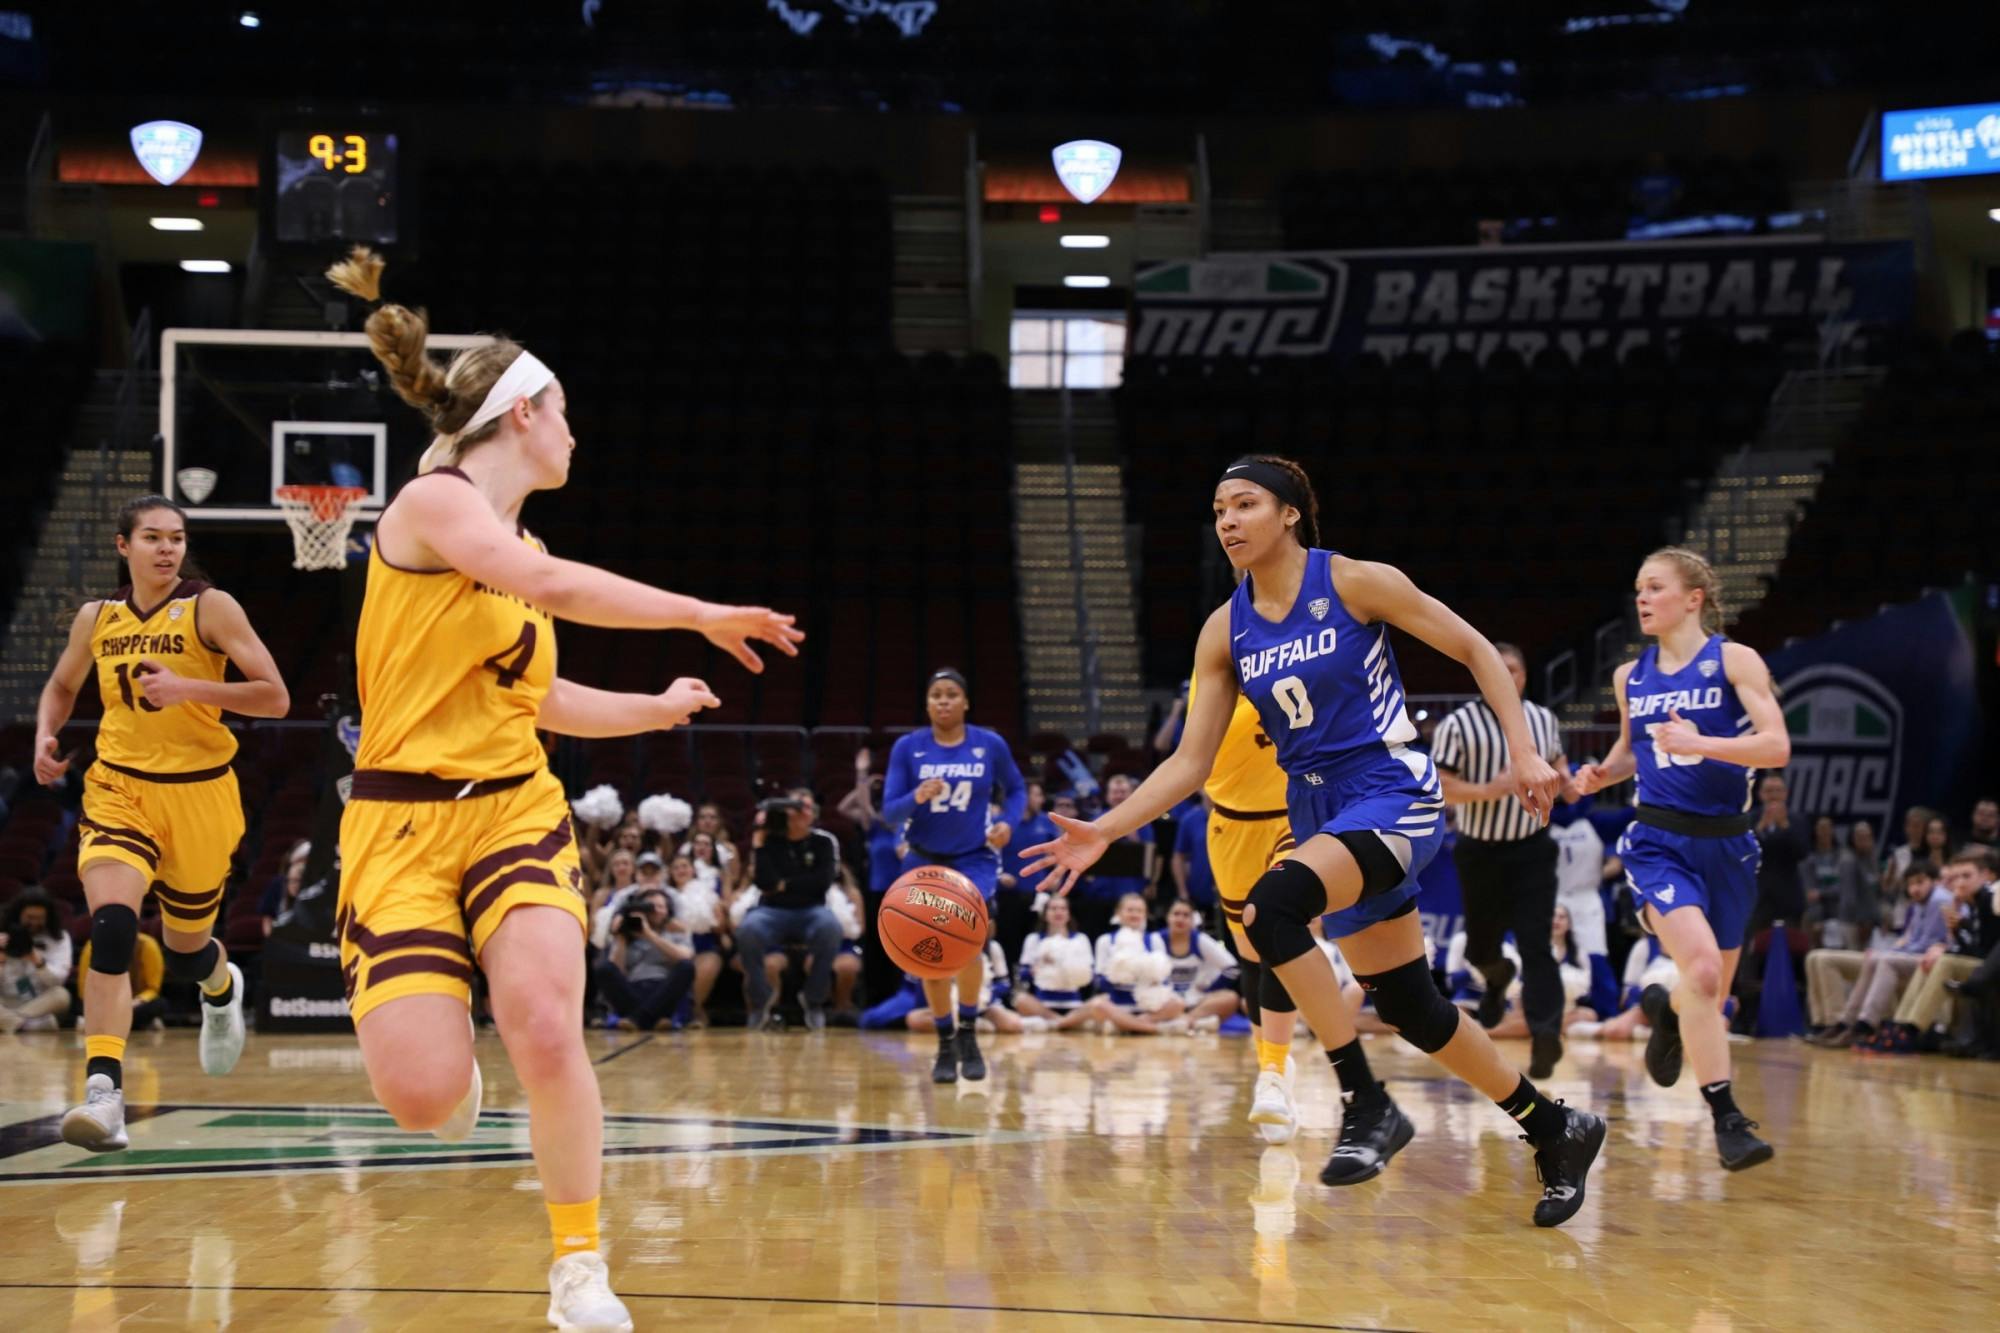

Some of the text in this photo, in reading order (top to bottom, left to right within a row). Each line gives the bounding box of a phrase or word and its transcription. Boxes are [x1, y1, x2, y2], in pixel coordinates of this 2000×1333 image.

[309, 134, 367, 174] 9.3
[1898, 150, 1968, 171] BEACH
[1364, 257, 1856, 326] BASKETBALL
[1134, 307, 1332, 358] MAC
[482, 620, 537, 690] 4
[1239, 627, 1337, 684] BUFFALO
[1271, 675, 1314, 729] 0
[1628, 687, 1722, 719] BUFFALO
[1645, 721, 1704, 769] 1
[918, 763, 985, 779] BUFFALO
[1784, 754, 1893, 816] MAC
[929, 780, 972, 813] 24
